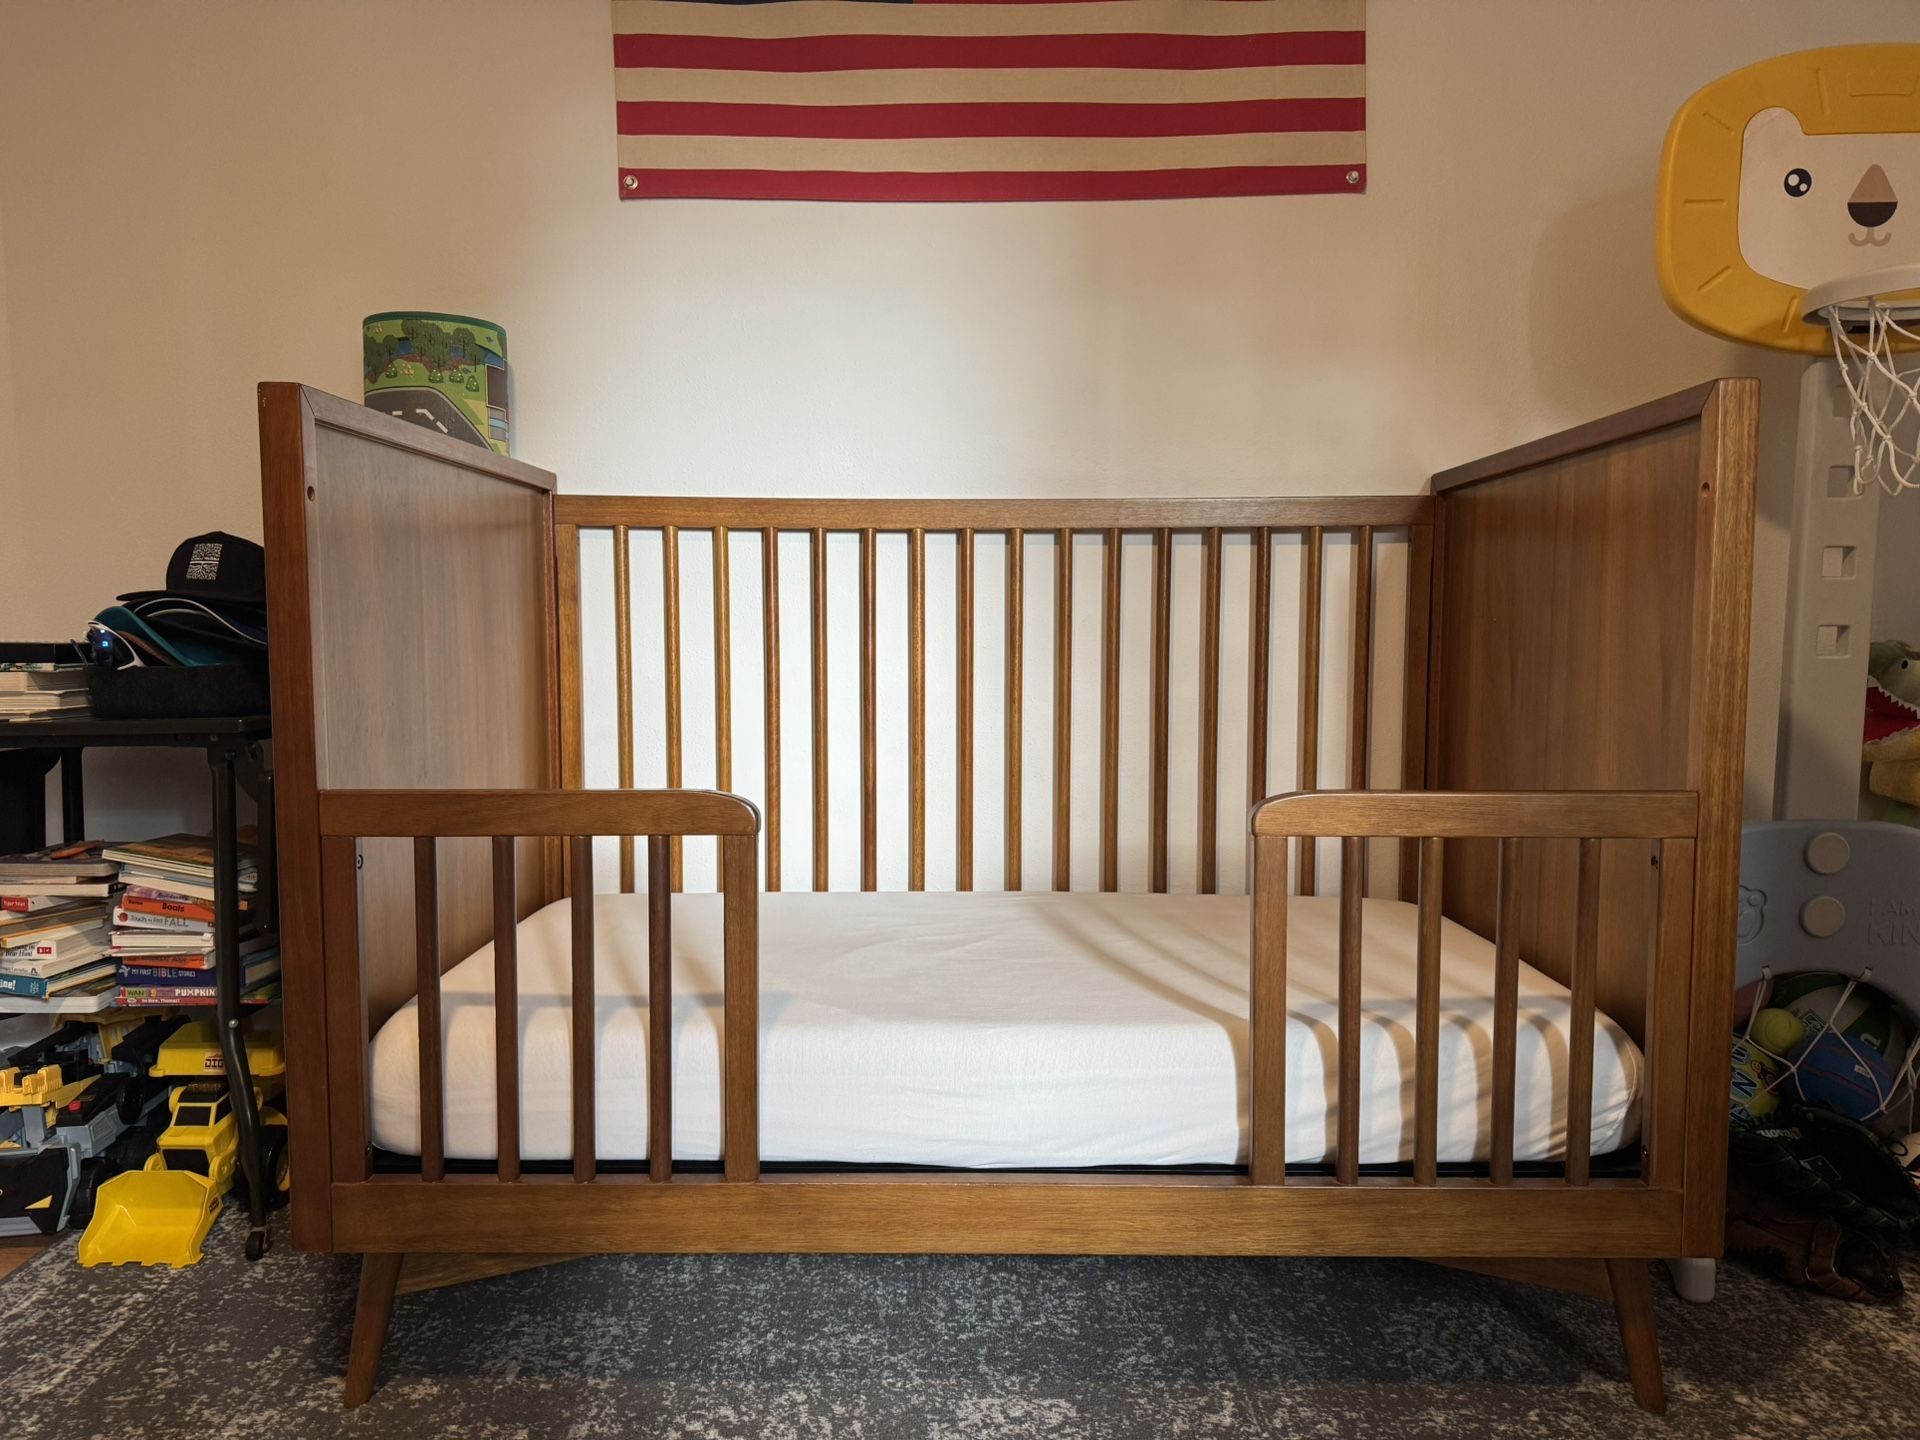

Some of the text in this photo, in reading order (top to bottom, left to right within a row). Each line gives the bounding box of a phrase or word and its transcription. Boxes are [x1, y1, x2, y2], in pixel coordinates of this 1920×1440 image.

[162, 903, 185, 912] Boats
[164, 917, 189, 927] FALL
[152, 968, 178, 978] BIBLE
[175, 989, 216, 997] PUMPKIN
